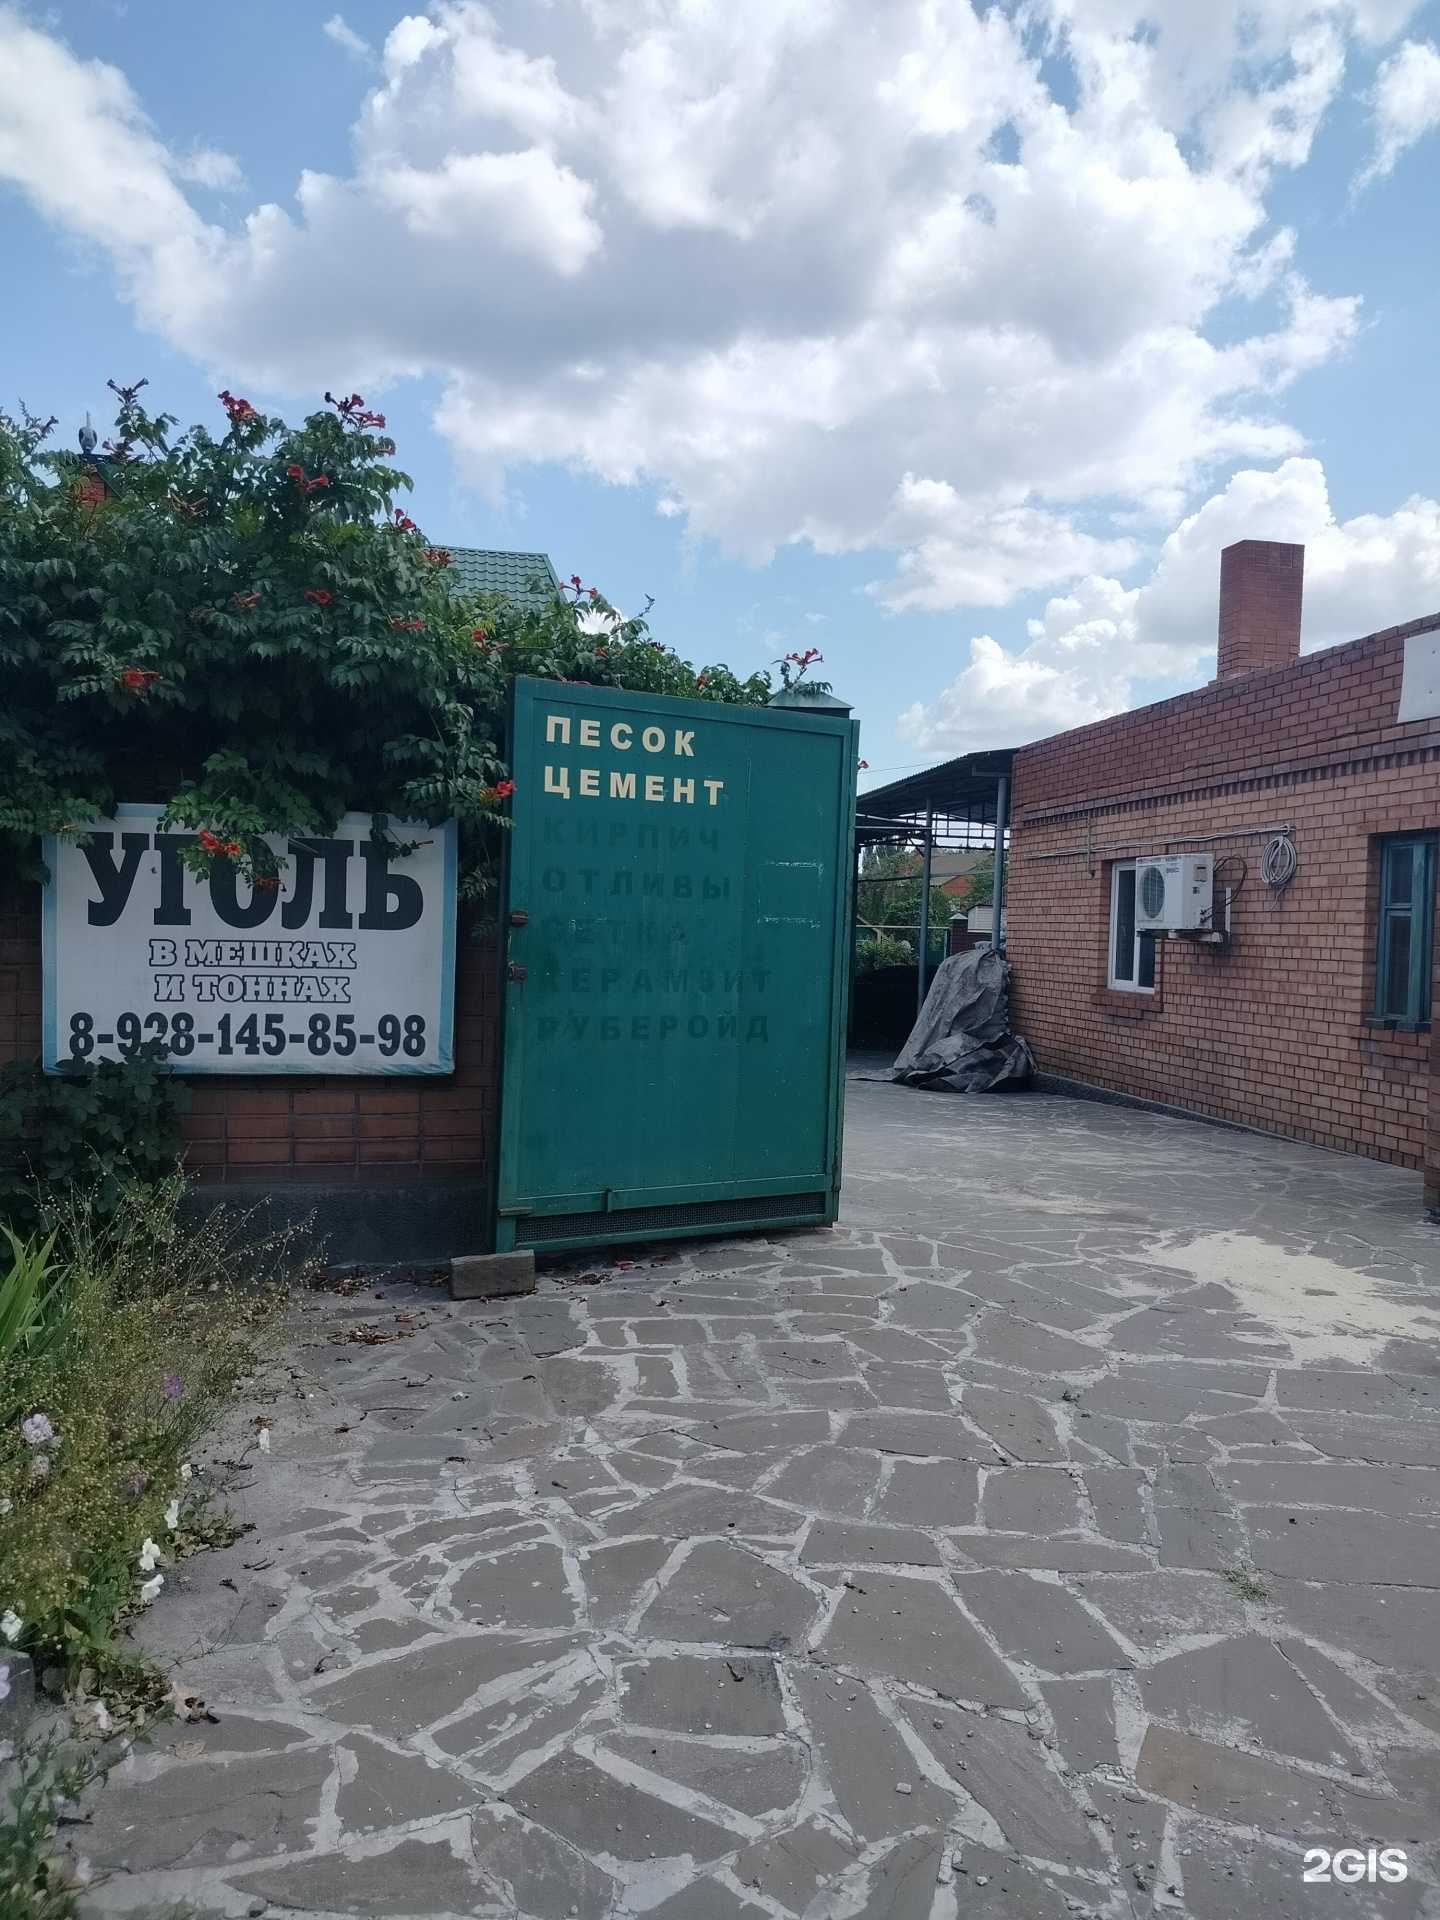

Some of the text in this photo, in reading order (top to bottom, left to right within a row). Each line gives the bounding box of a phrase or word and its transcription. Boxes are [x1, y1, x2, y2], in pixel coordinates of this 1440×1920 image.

[546, 715, 695, 757] ПЕСОК
[544, 766, 724, 806] ЦЕМЕНТ
[543, 816, 719, 852] КИРПИЧ
[76, 832, 424, 931] УГОЛЬ
[542, 866, 731, 901] ОТЛИВЫ
[149, 938, 358, 969] В МЕШКАХ
[154, 974, 352, 1003] И ТОННАХ
[69, 1011, 427, 1058] 8-928-145-85-98
[537, 1009, 769, 1043] РУБЕРОЙД
